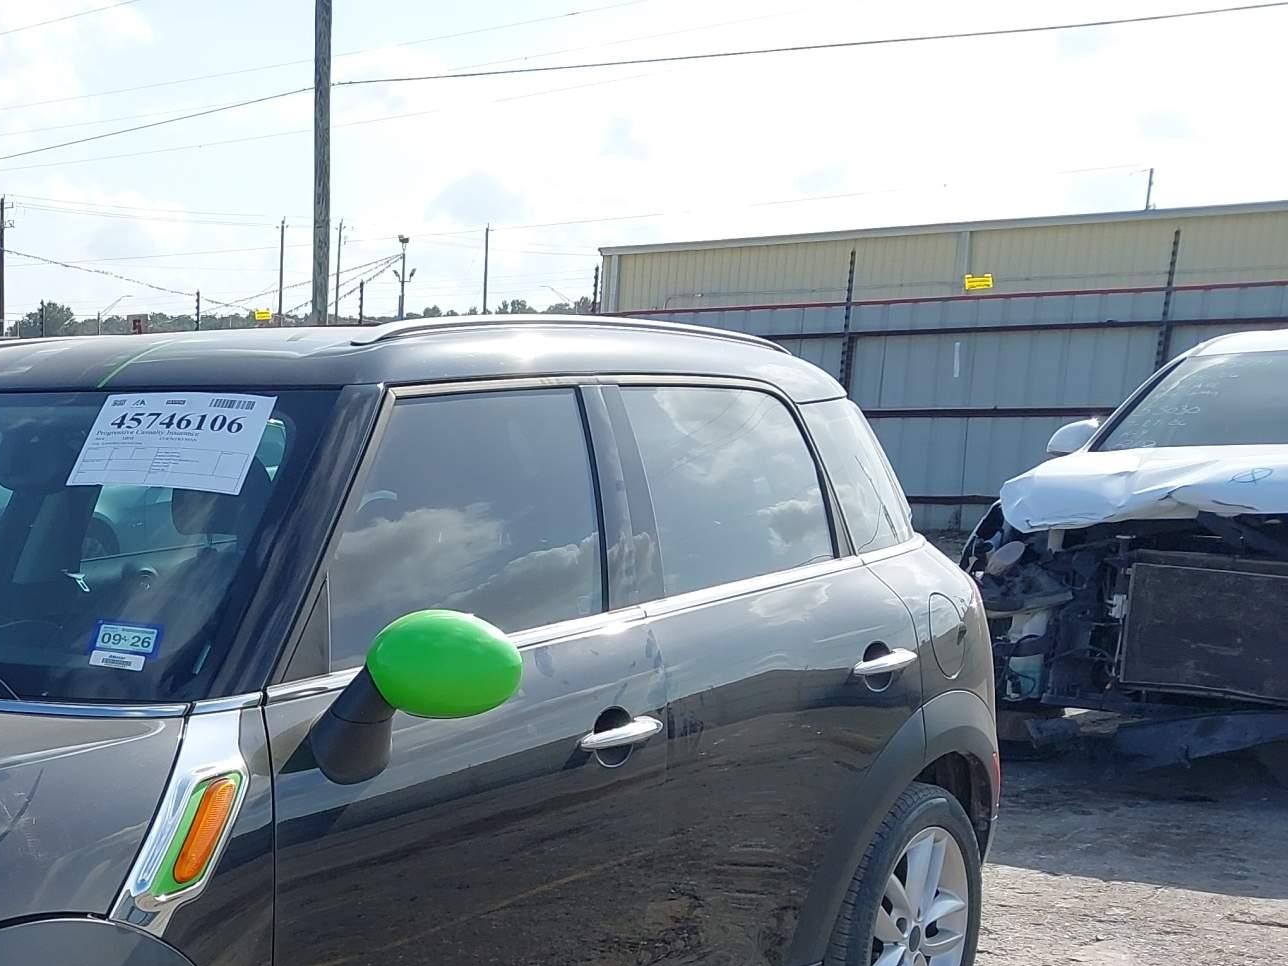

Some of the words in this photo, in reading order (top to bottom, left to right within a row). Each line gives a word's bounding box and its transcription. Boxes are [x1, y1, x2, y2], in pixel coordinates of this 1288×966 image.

[110, 411, 247, 434] 45746106
[101, 632, 122, 645] 09
[129, 635, 152, 648] 26
